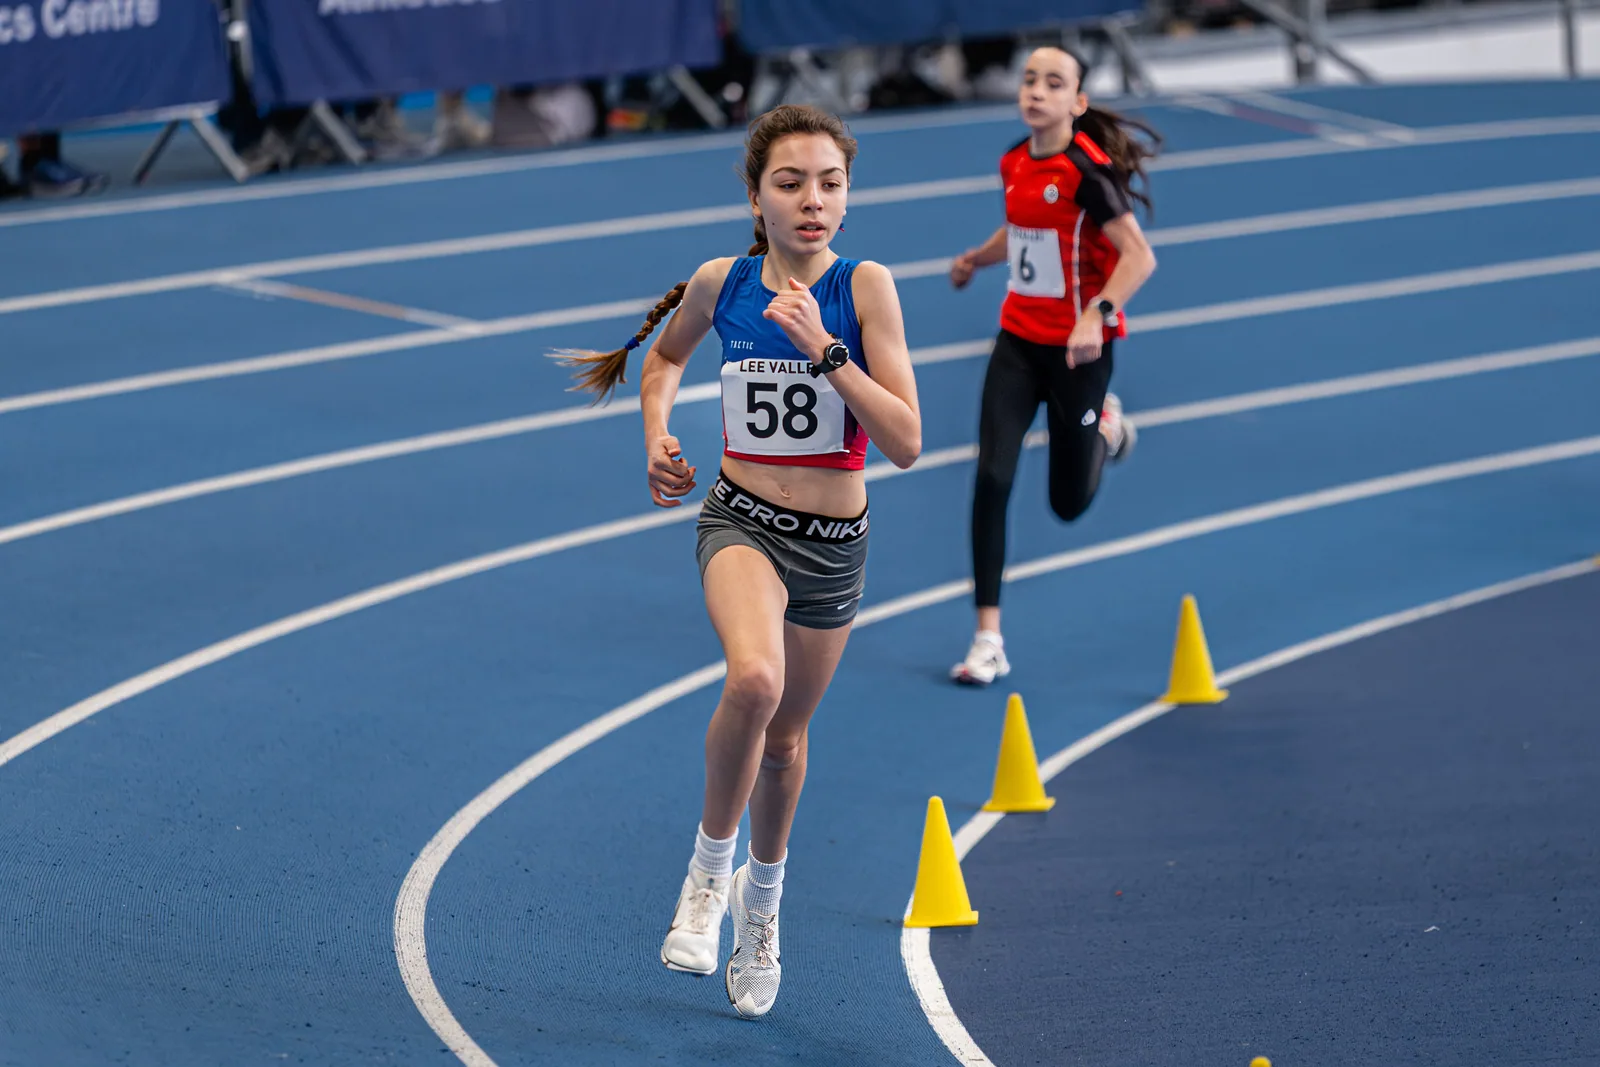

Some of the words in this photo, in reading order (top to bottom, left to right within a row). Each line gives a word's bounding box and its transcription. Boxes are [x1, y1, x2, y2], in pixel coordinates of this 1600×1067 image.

[41, 0, 160, 38] Centre
[1019, 245, 1036, 285] 6
[739, 361, 765, 373] LEE
[769, 361, 813, 374] VALLE
[746, 382, 818, 439] 58
[729, 493, 799, 531] PRO
[805, 510, 869, 538] NIKE
